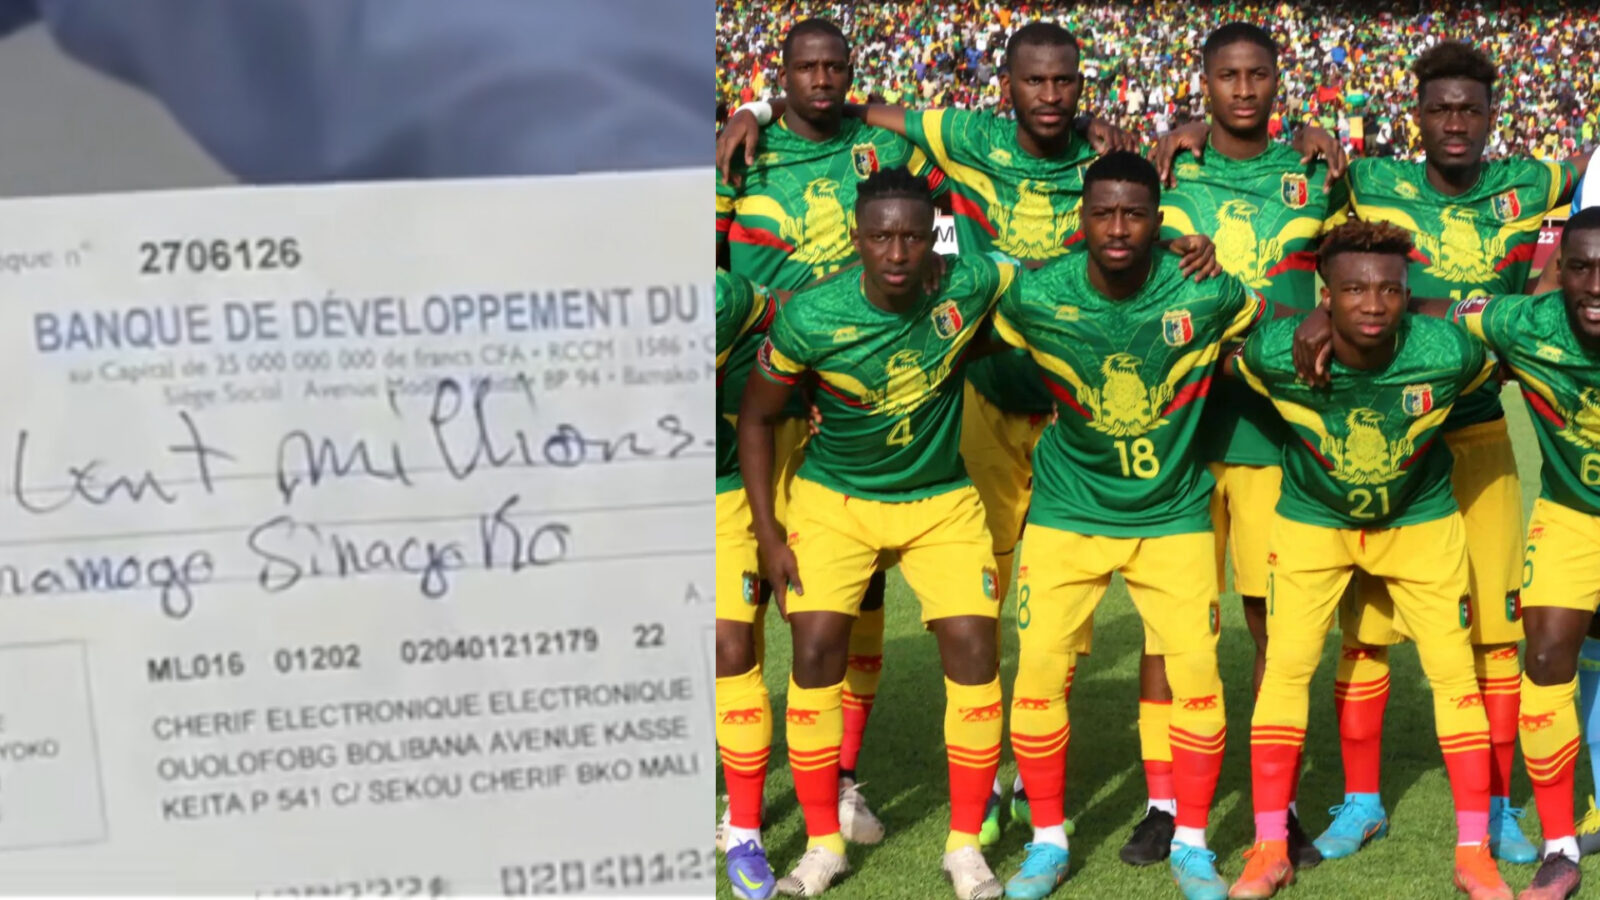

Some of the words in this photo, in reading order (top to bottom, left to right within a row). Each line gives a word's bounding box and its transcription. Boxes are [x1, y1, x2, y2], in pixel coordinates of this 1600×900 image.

[138, 237, 303, 274] 2706126
[33, 304, 212, 353] BANQUE
[223, 301, 280, 343] DE
[291, 287, 632, 341] DÉVELOPPEMENT
[646, 284, 699, 326] DU
[181, 358, 207, 377] de
[215, 354, 240, 376] 25
[245, 351, 287, 374] 000
[291, 350, 332, 372] 000
[336, 348, 376, 370] 000
[382, 346, 407, 369] de
[480, 344, 527, 366] CFA
[886, 416, 914, 447] 4
[1112, 437, 1161, 480] 18
[1347, 486, 1390, 518] 21
[147, 652, 246, 683] ML016
[274, 644, 362, 674] 01202
[400, 628, 599, 664] 020401212179
[633, 622, 665, 649] 22
[152, 709, 257, 741] CHERIF
[267, 693, 482, 732] ELECTRONIQUE
[488, 678, 694, 716] ELECTRONIQUE
[156, 746, 337, 782] OUOLOFOBG
[346, 732, 481, 766] BOLIBANA
[489, 723, 597, 755] AVENUE
[603, 716, 690, 746] KASSE
[163, 793, 245, 820] KEITA
[251, 790, 269, 812] P
[276, 786, 322, 811] 541
[368, 773, 463, 803] SEKOU
[469, 764, 568, 794] CHERIF
[576, 758, 632, 785] BKO
[639, 753, 700, 779] MALI
